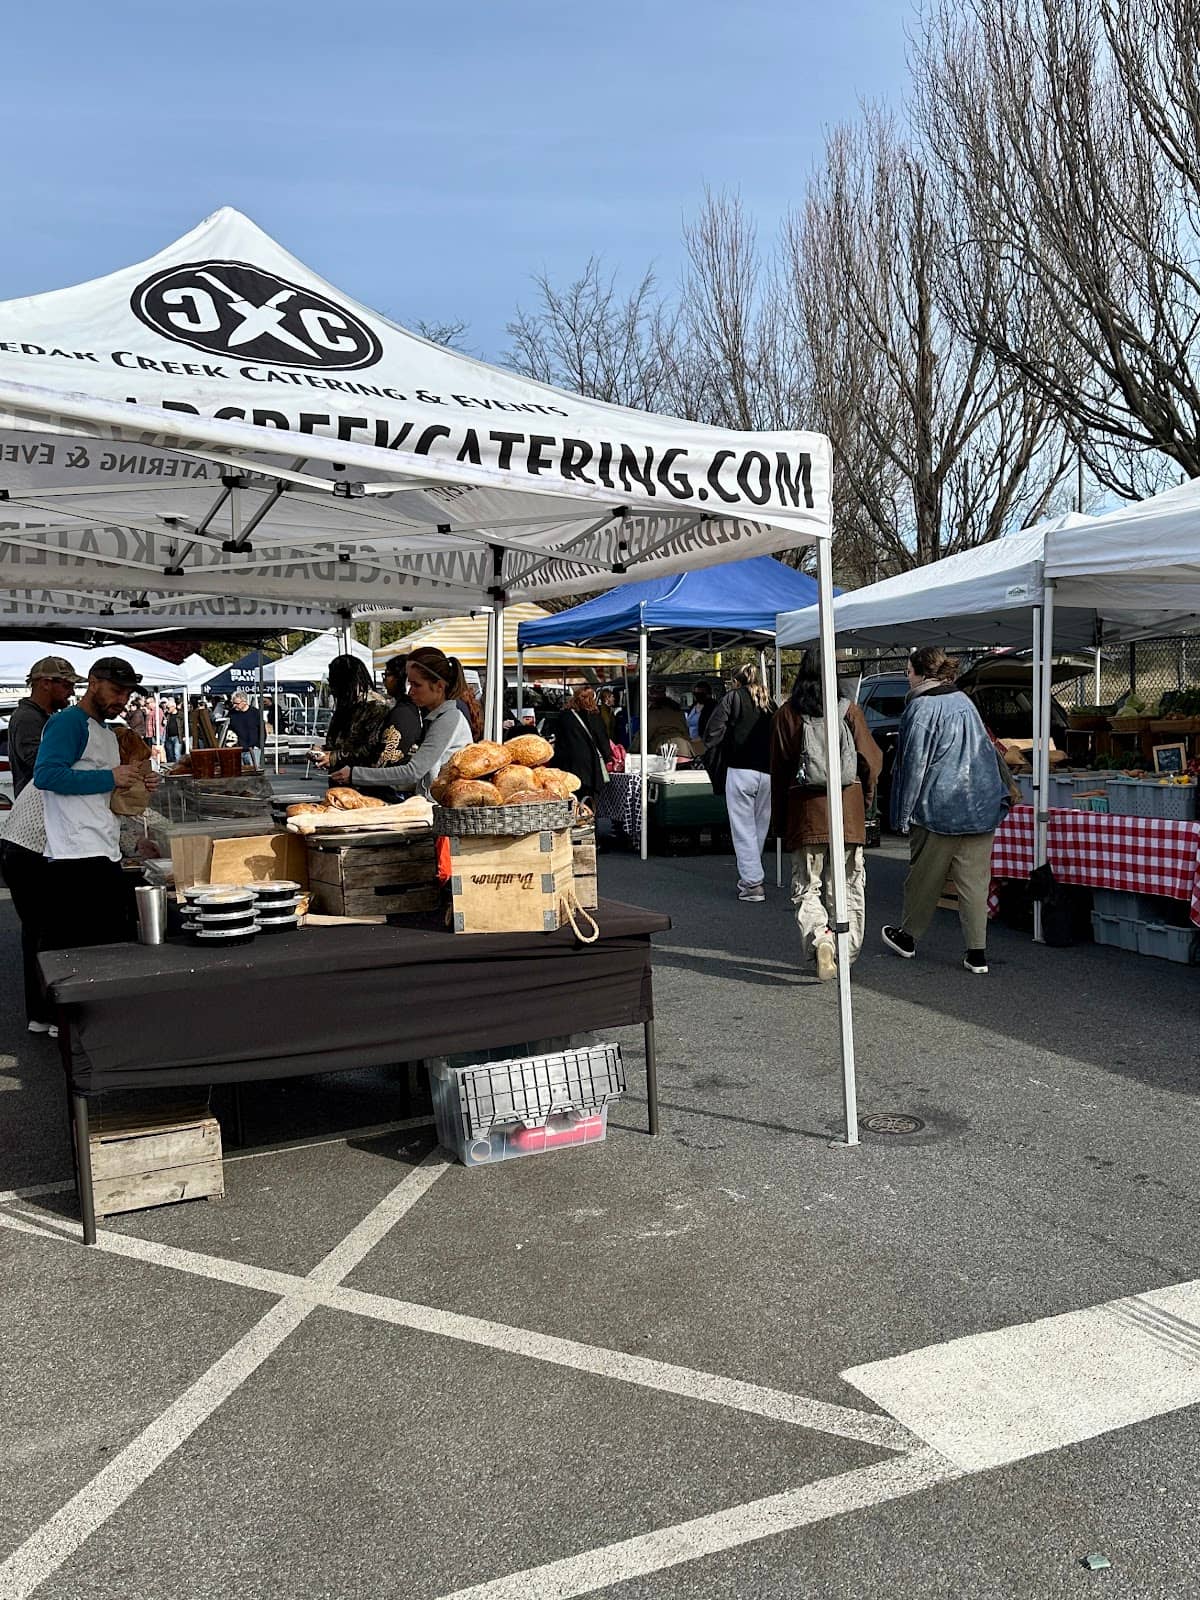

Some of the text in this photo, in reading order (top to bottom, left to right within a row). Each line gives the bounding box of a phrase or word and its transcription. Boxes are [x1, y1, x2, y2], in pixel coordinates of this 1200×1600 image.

[111, 351, 230, 379] CREEK
[239, 367, 407, 401] CATERING
[415, 389, 448, 406] &
[450, 394, 569, 417] EVENTS
